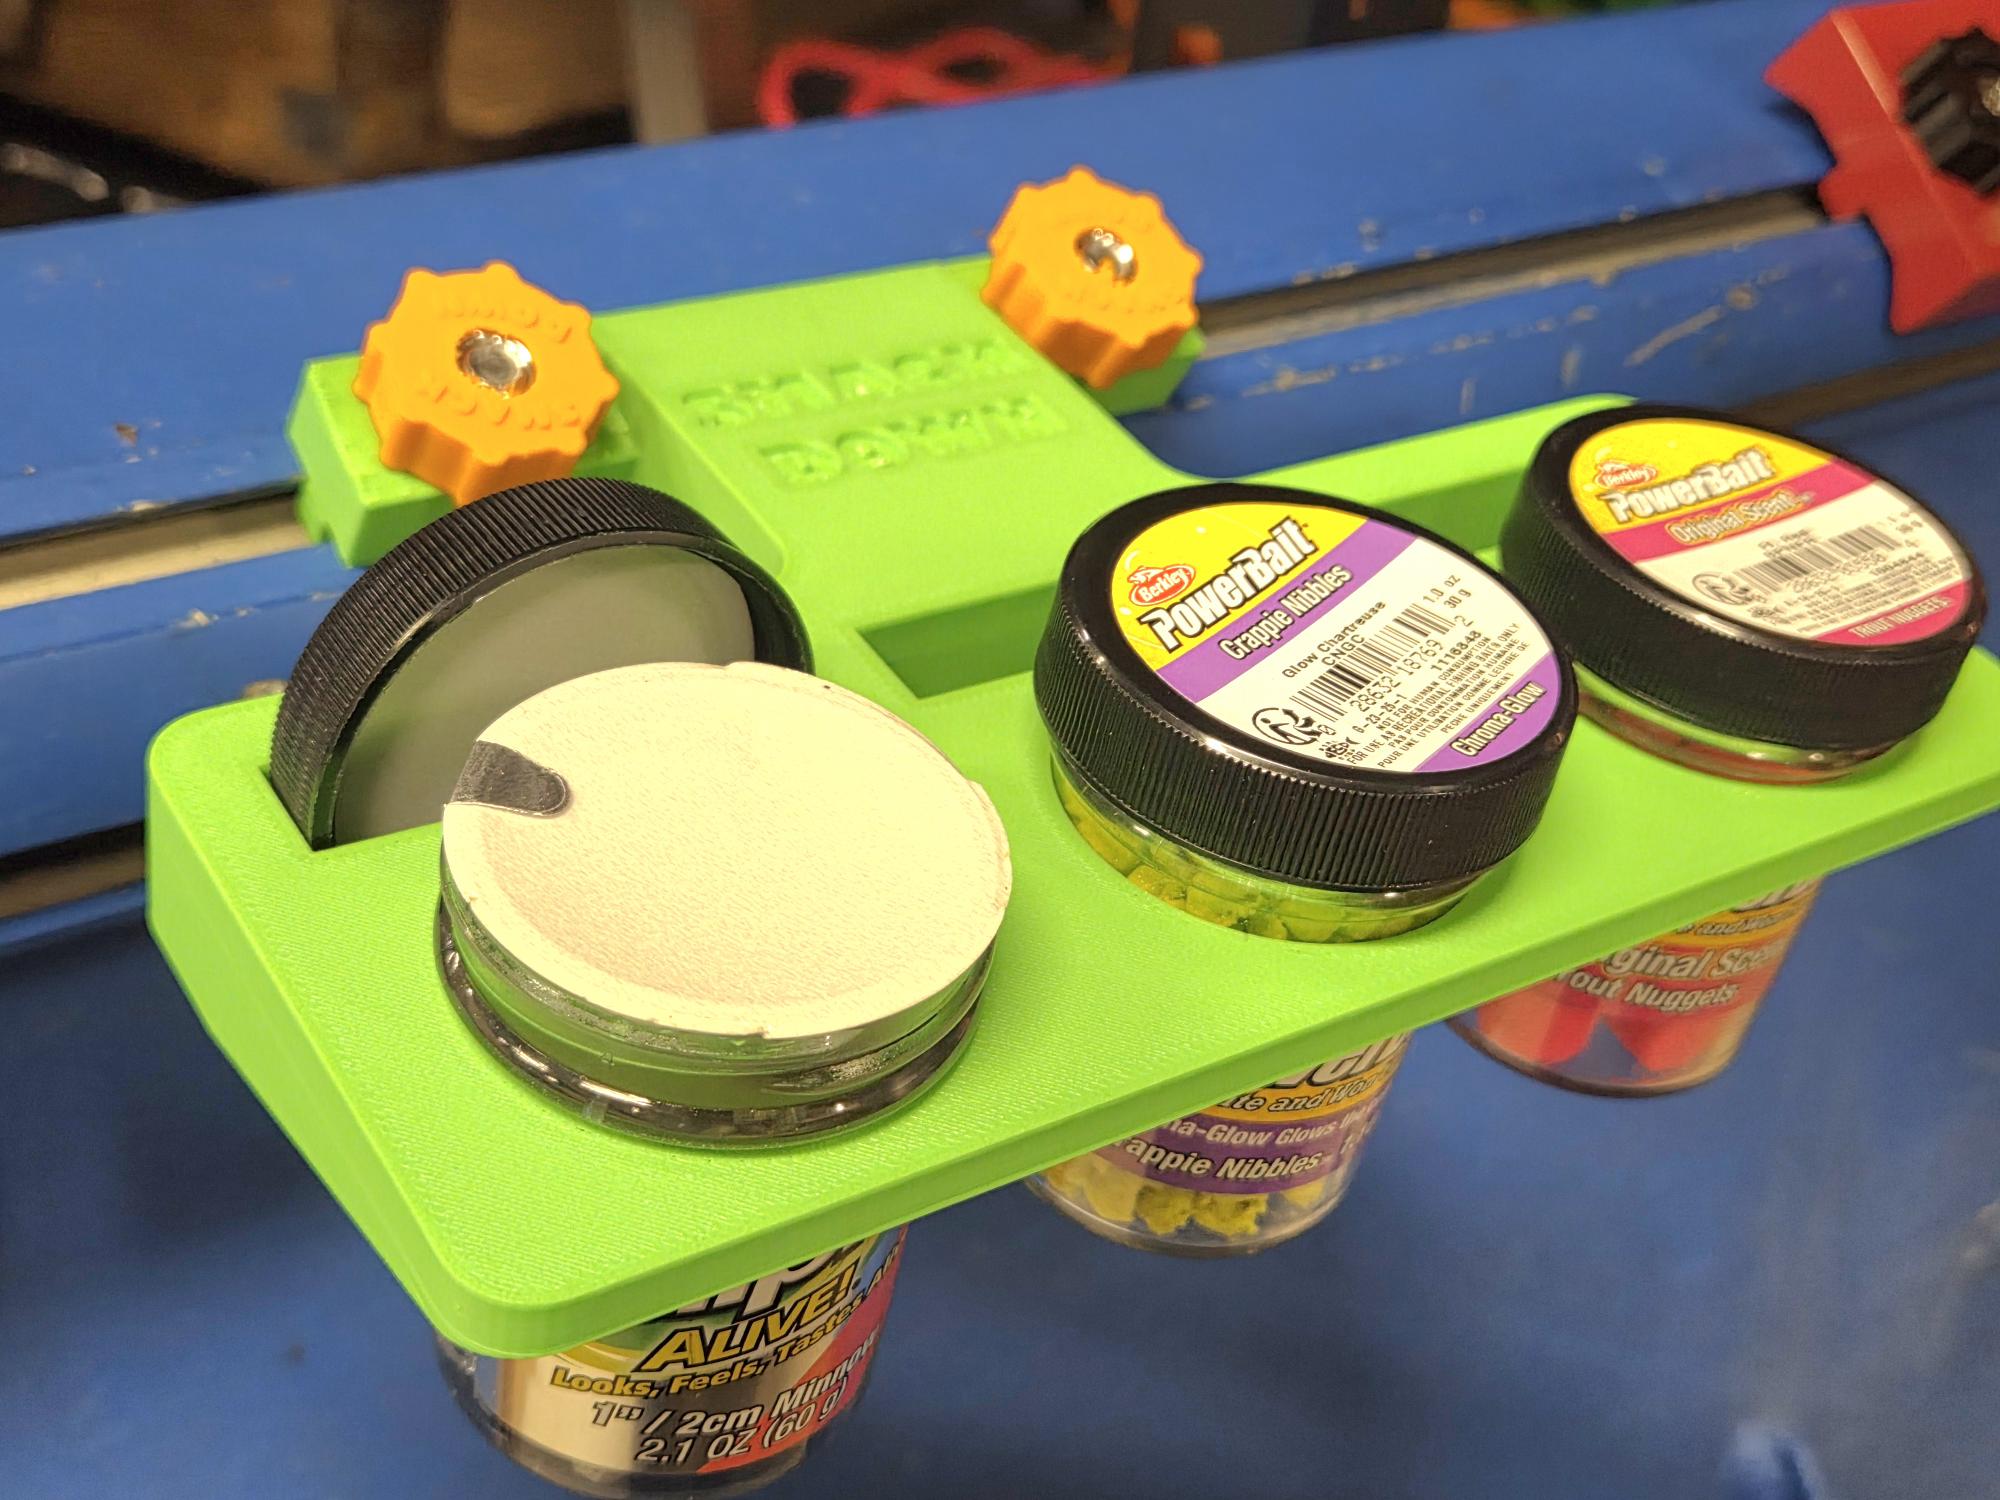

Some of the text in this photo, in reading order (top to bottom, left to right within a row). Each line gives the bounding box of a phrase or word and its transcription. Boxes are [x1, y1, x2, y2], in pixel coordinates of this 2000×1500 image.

[1597, 446, 1776, 524] PowerBait
[1670, 511, 1745, 543] Original
[1741, 491, 1795, 521] Scent
[1137, 516, 1318, 653] PowerBait
[1138, 566, 1191, 603] Berkley
[1423, 575, 1461, 603] 1.0 oz
[1443, 588, 1472, 609] 30 g
[1218, 563, 1353, 660] Crappie Nibbles
[1282, 601, 1387, 679] Glow Chartreuse
[1321, 634, 1366, 667] CNGC
[1350, 675, 1402, 712] 28632
[1396, 639, 1444, 676] 18769
[1454, 615, 1474, 628] 2
[1347, 622, 1520, 765] FOR USE AS RECREATIONAL FISHING BAITS ONLY
[1376, 636, 1491, 731] NOT FOR HUMAN CONSUMPTION
[1388, 734, 1408, 748] PAS
[1405, 717, 1430, 735] POUR
[1483, 638, 1520, 669] HUMAINE
[1466, 672, 1515, 714] UNIQUEMENT
[1377, 750, 1403, 768] POUR
[1462, 677, 1492, 701] COMME
[1450, 680, 1547, 757] Chroma-Glow
[1602, 944, 1710, 978] ginal
[1624, 980, 1741, 1012] Nuggets
[1268, 1086, 1331, 1113] and
[1273, 1120, 1338, 1145] Glows
[1214, 1150, 1321, 1180] Nibbles
[632, 1257, 862, 1372] ALIVE!
[551, 1364, 661, 1400] Looks,
[668, 1358, 770, 1396] Feels,
[634, 1436, 698, 1467] 2.1
[761, 1399, 819, 1450] (60
[817, 1376, 850, 1422] g)
[641, 1409, 673, 1436] /
[675, 1404, 765, 1437] 2cm
